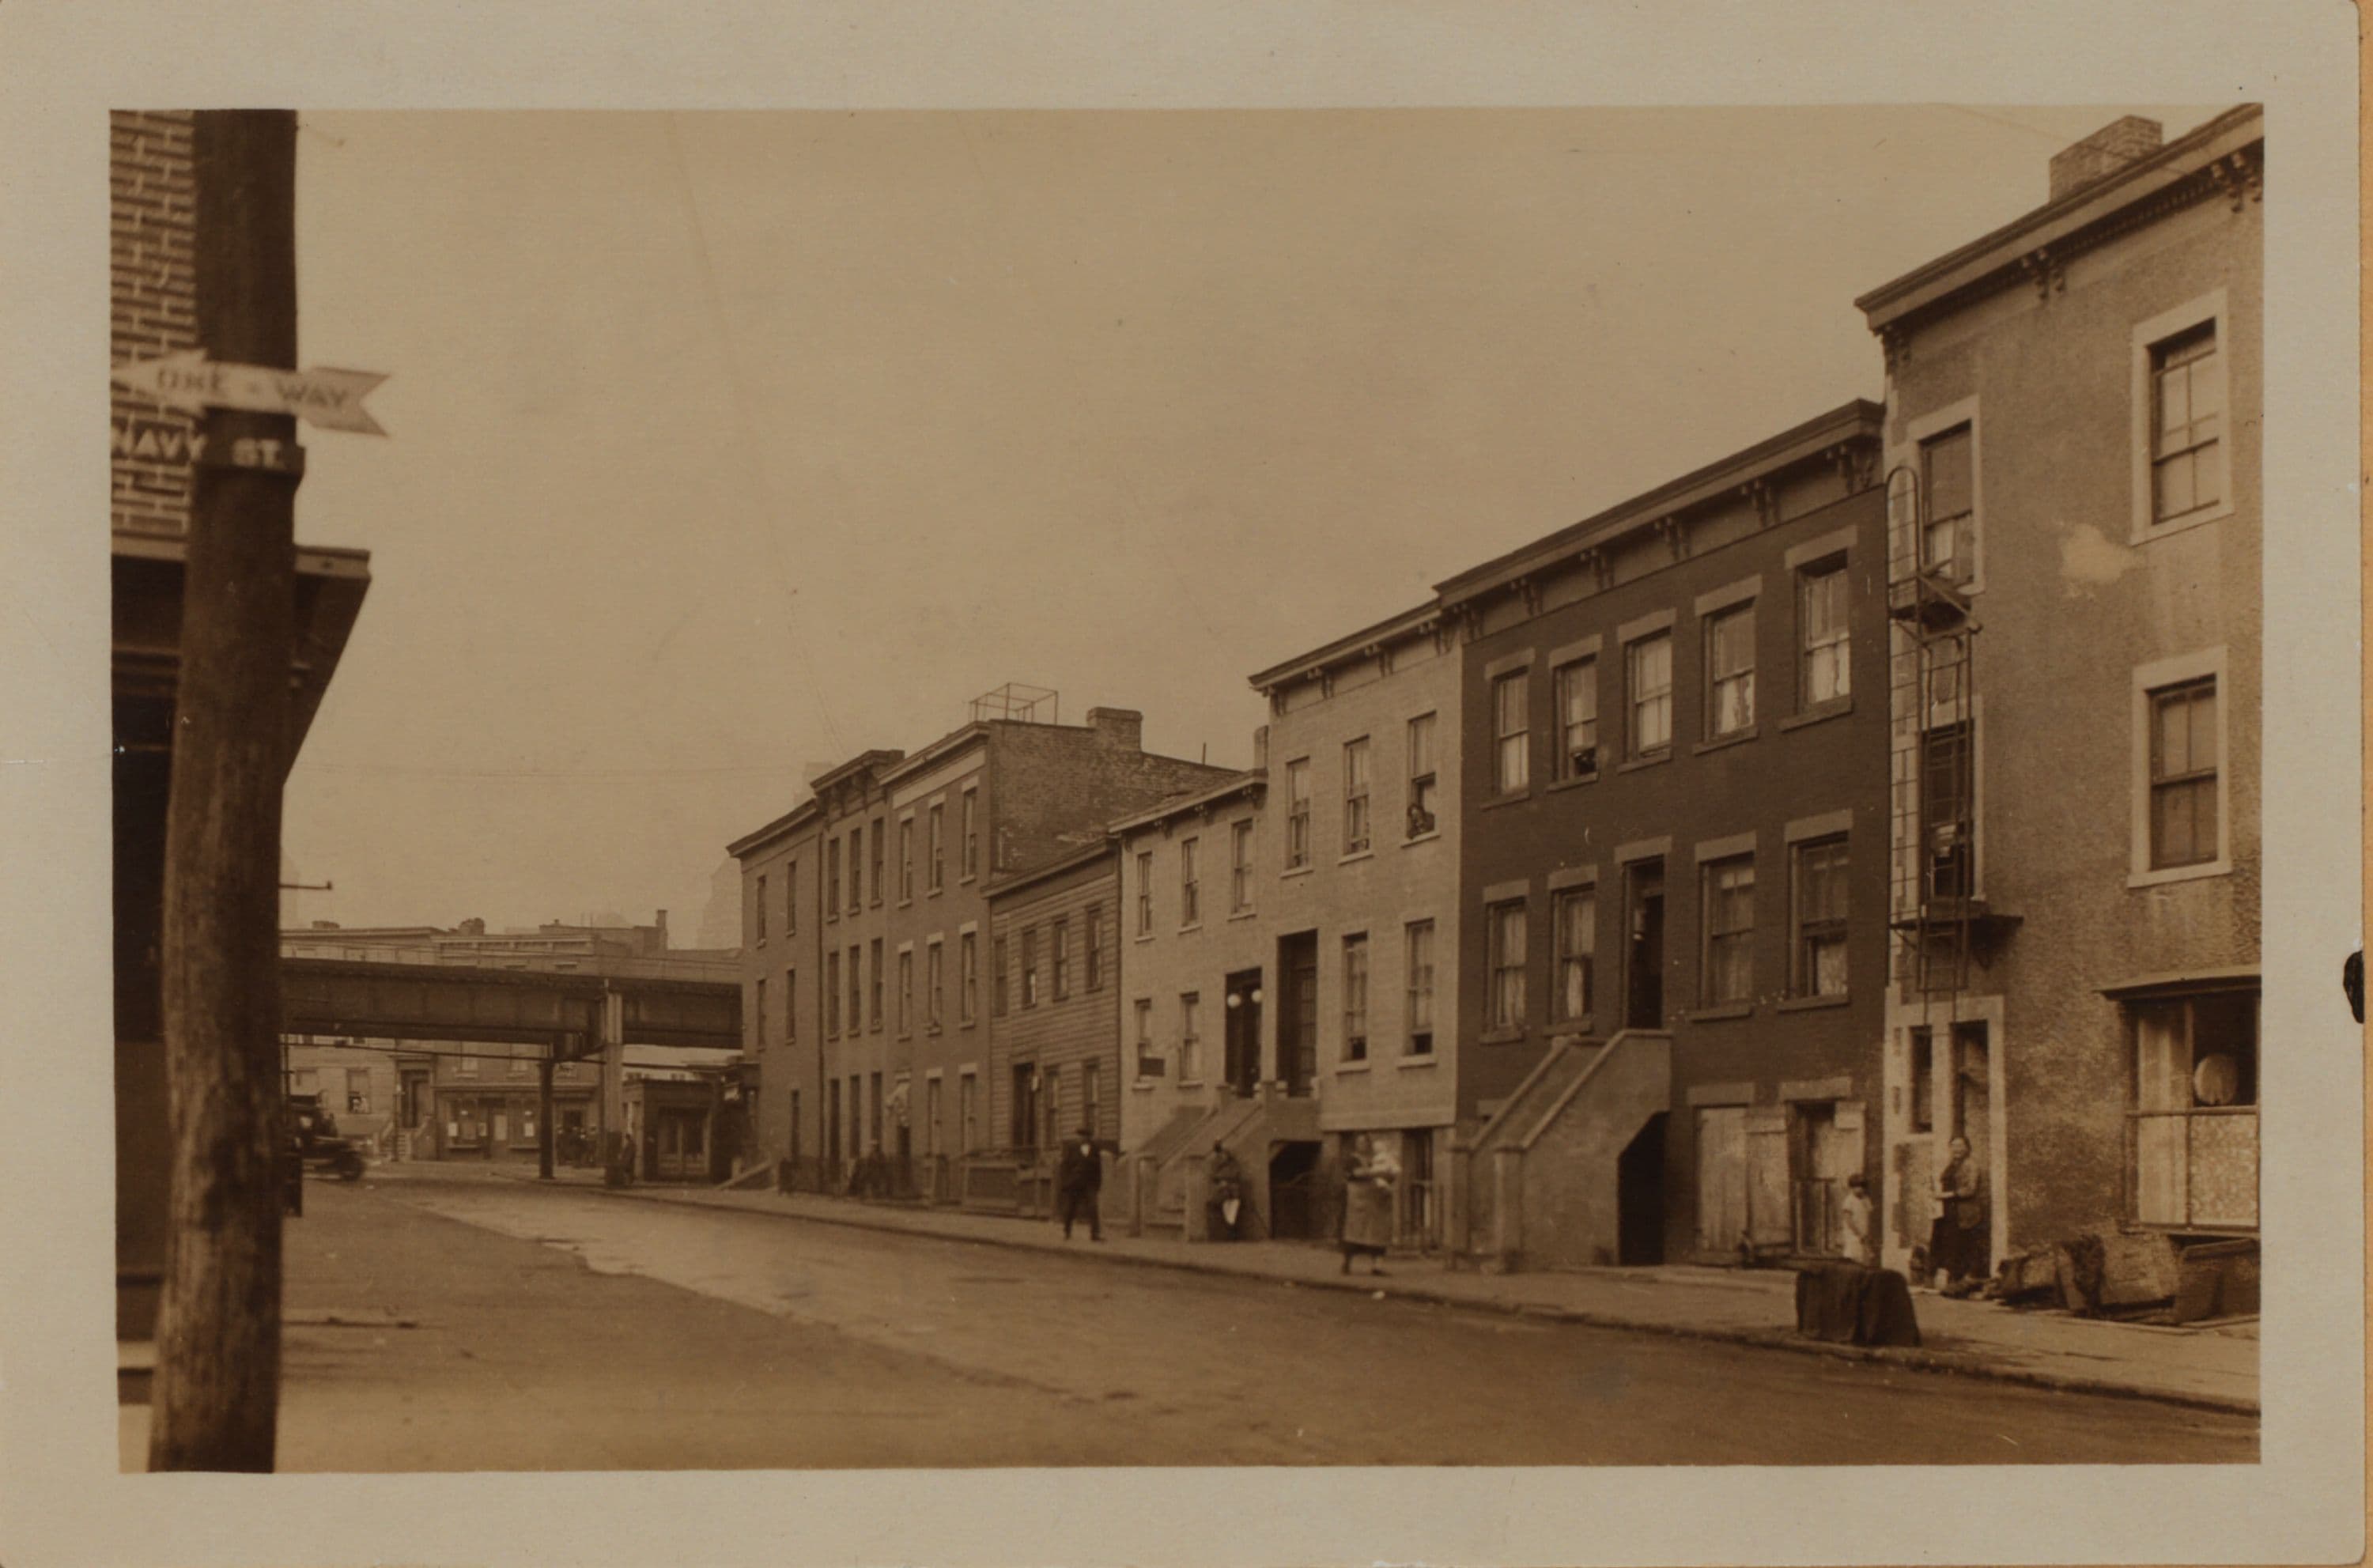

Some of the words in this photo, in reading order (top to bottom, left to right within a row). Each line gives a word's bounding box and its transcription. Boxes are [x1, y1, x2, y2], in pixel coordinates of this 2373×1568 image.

[157, 368, 224, 391] ONE
[277, 378, 348, 406] WAY
[112, 425, 208, 460] NAVY
